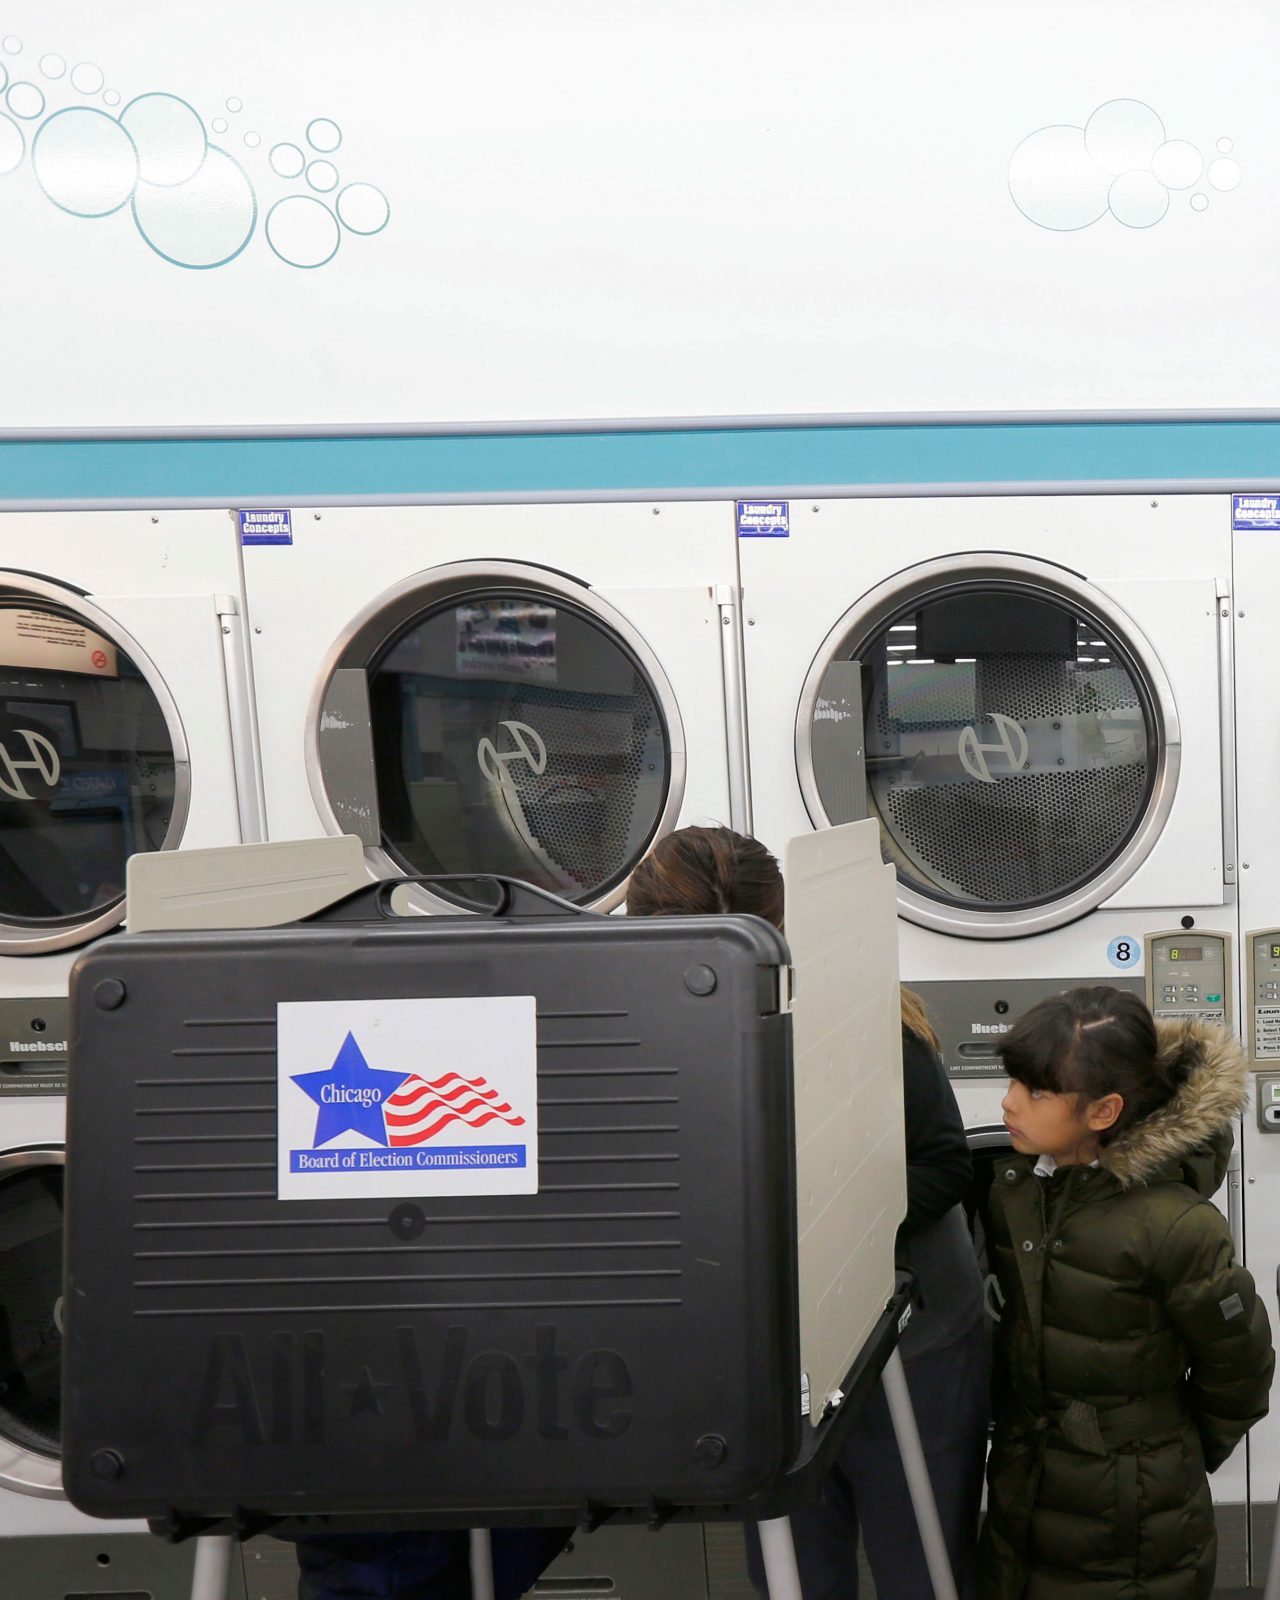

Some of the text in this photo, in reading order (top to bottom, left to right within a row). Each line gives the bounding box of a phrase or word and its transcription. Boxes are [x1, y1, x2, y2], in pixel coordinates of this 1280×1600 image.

[743, 504, 782, 516] Laundry
[1239, 498, 1277, 510] Laundry
[245, 512, 285, 524] Laundry
[242, 523, 289, 534] Concepts
[1116, 942, 1130, 961] 8
[1171, 949, 1179, 960] 8
[1273, 946, 1280, 957] 9
[972, 1023, 1015, 1034] Hueb
[320, 1084, 381, 1108] Chicago
[299, 1150, 518, 1169] Board of Election Commissioners
[193, 1323, 634, 1446] All Vote
